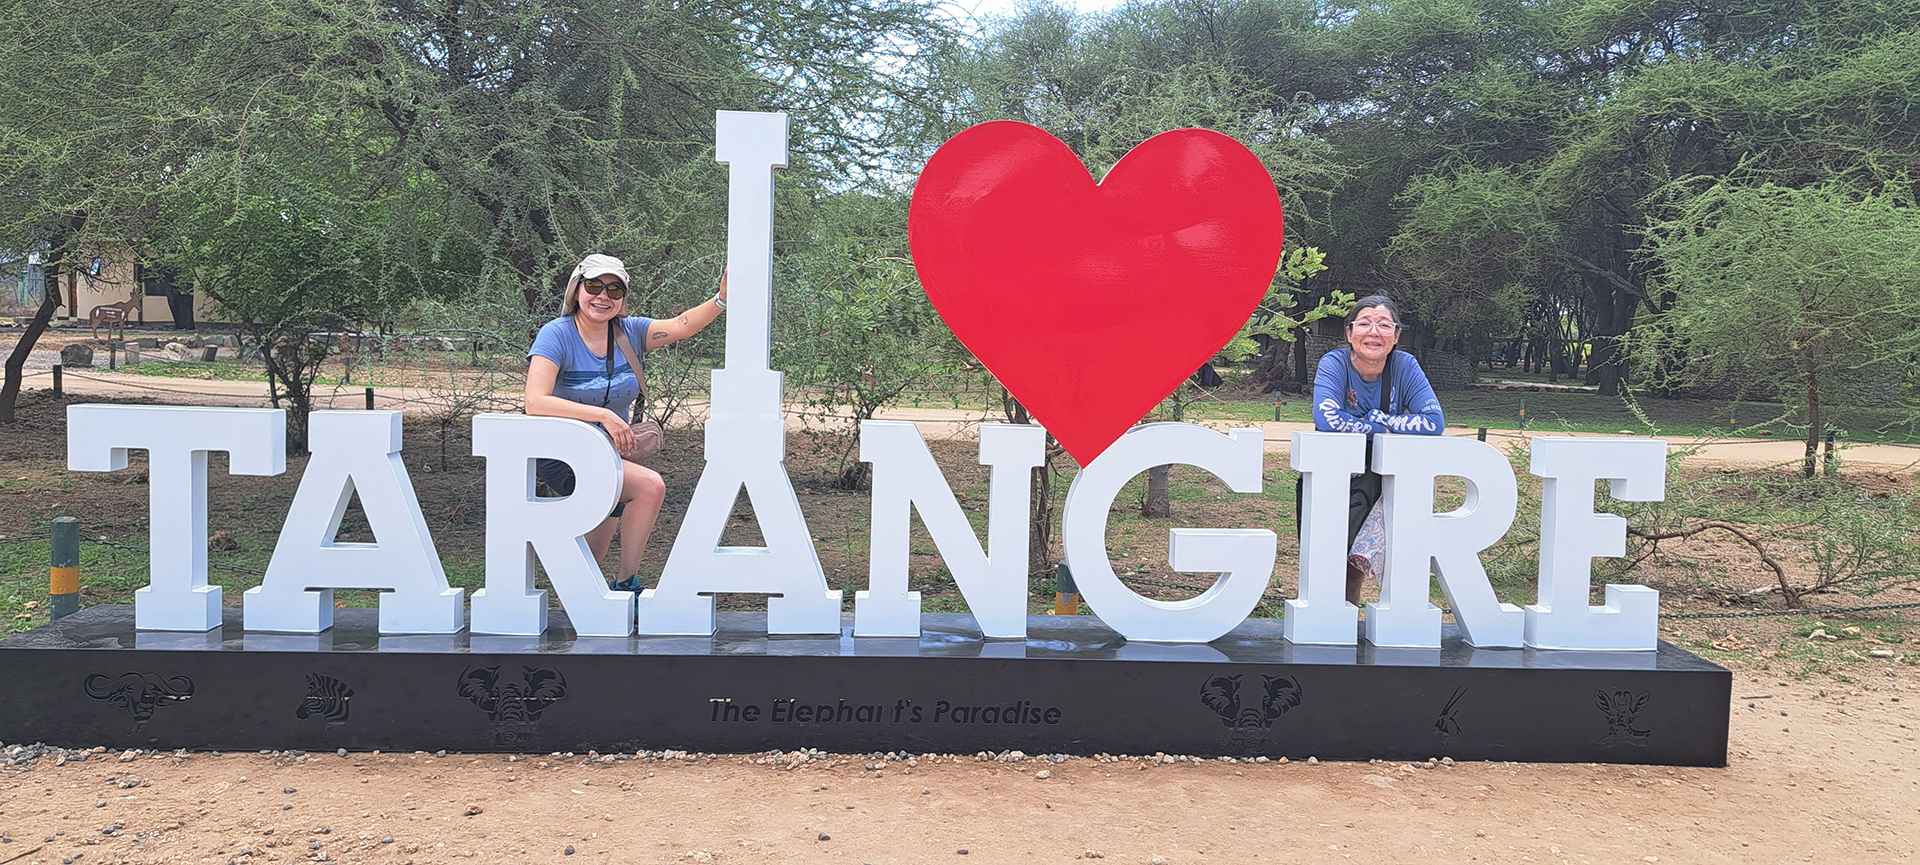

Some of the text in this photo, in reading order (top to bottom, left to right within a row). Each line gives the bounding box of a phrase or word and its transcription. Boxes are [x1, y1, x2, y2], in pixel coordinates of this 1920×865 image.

[711, 109, 789, 420] I
[66, 402, 1667, 651] TARANGIRE
[709, 698, 761, 723] The
[932, 700, 1063, 726] Paradise
